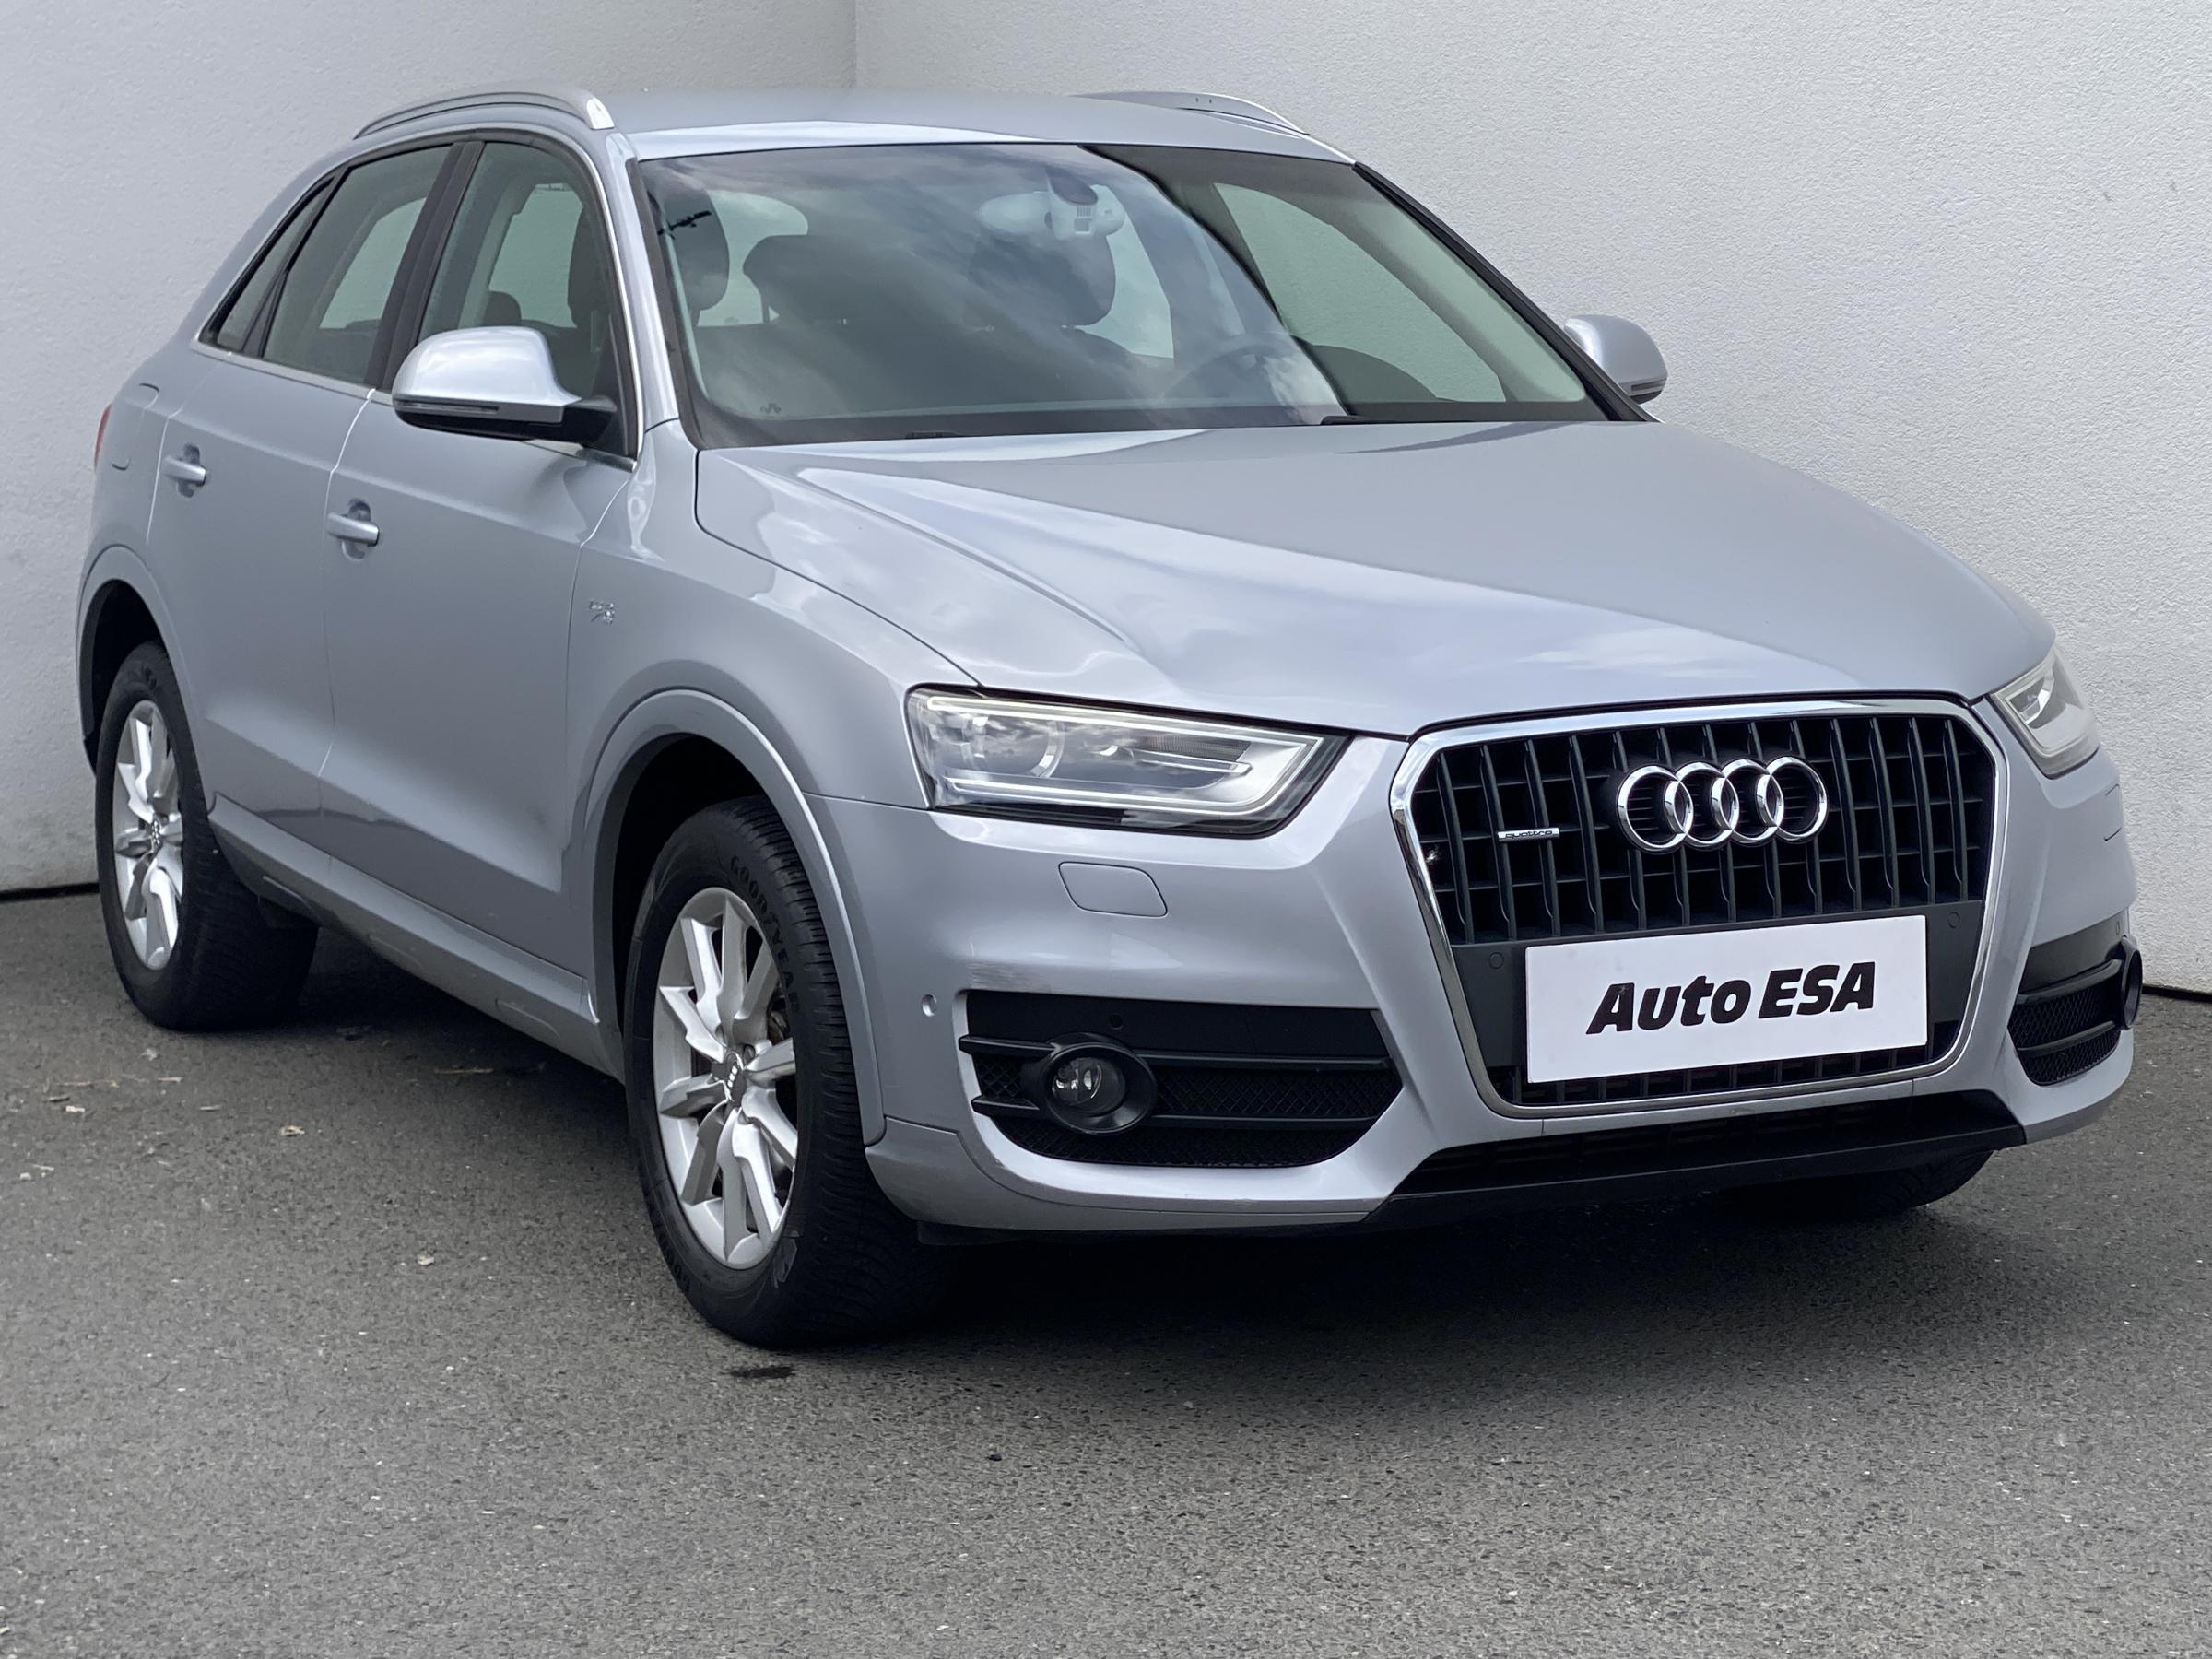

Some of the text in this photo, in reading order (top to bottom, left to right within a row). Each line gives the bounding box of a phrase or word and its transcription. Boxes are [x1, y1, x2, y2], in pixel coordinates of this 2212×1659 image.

[1505, 830, 1553, 840] quattro
[1585, 961, 1876, 1035] Auto ESA
